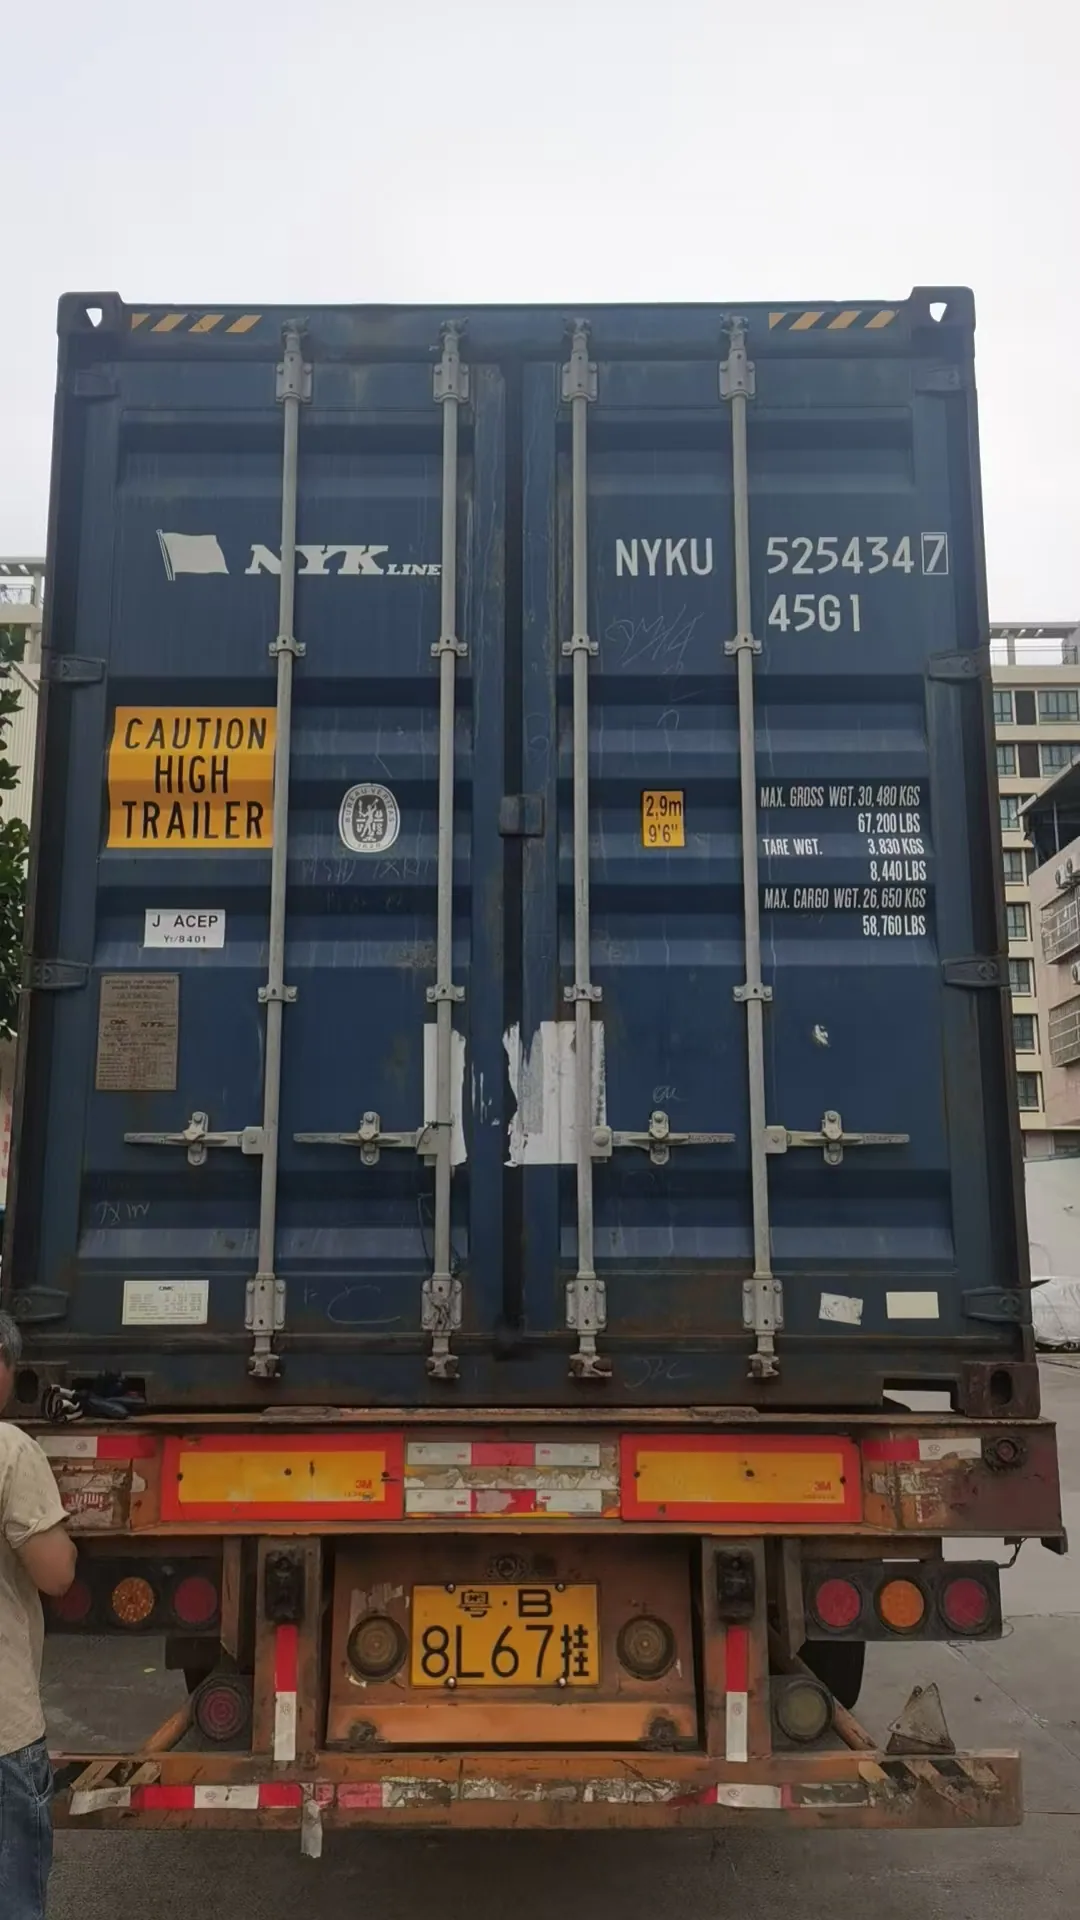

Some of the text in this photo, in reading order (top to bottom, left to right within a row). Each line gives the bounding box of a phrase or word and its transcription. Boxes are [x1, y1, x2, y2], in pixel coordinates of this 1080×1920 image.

[244, 544, 442, 576] NYK LINE
[615, 538, 713, 577] NYKU
[768, 594, 860, 632] 45G1
[124, 717, 267, 750] CAUTION
[155, 755, 229, 794] HIGH
[760, 785, 921, 808] MAX. GROSS WGT. 30,480 KGS
[122, 800, 264, 839] TRAILER
[857, 812, 921, 834] 67,200 LBS
[762, 837, 925, 856] TARE WGT. 3,830 KGS
[869, 860, 927, 882] 8,440 LBS
[763, 887, 927, 910] MAX. CARGO WGT. 26,650 KGS
[152, 915, 219, 928] J ACEP
[862, 914, 927, 937] 58,760 LBS
[421, 1624, 590, 1678] 8L67挂
